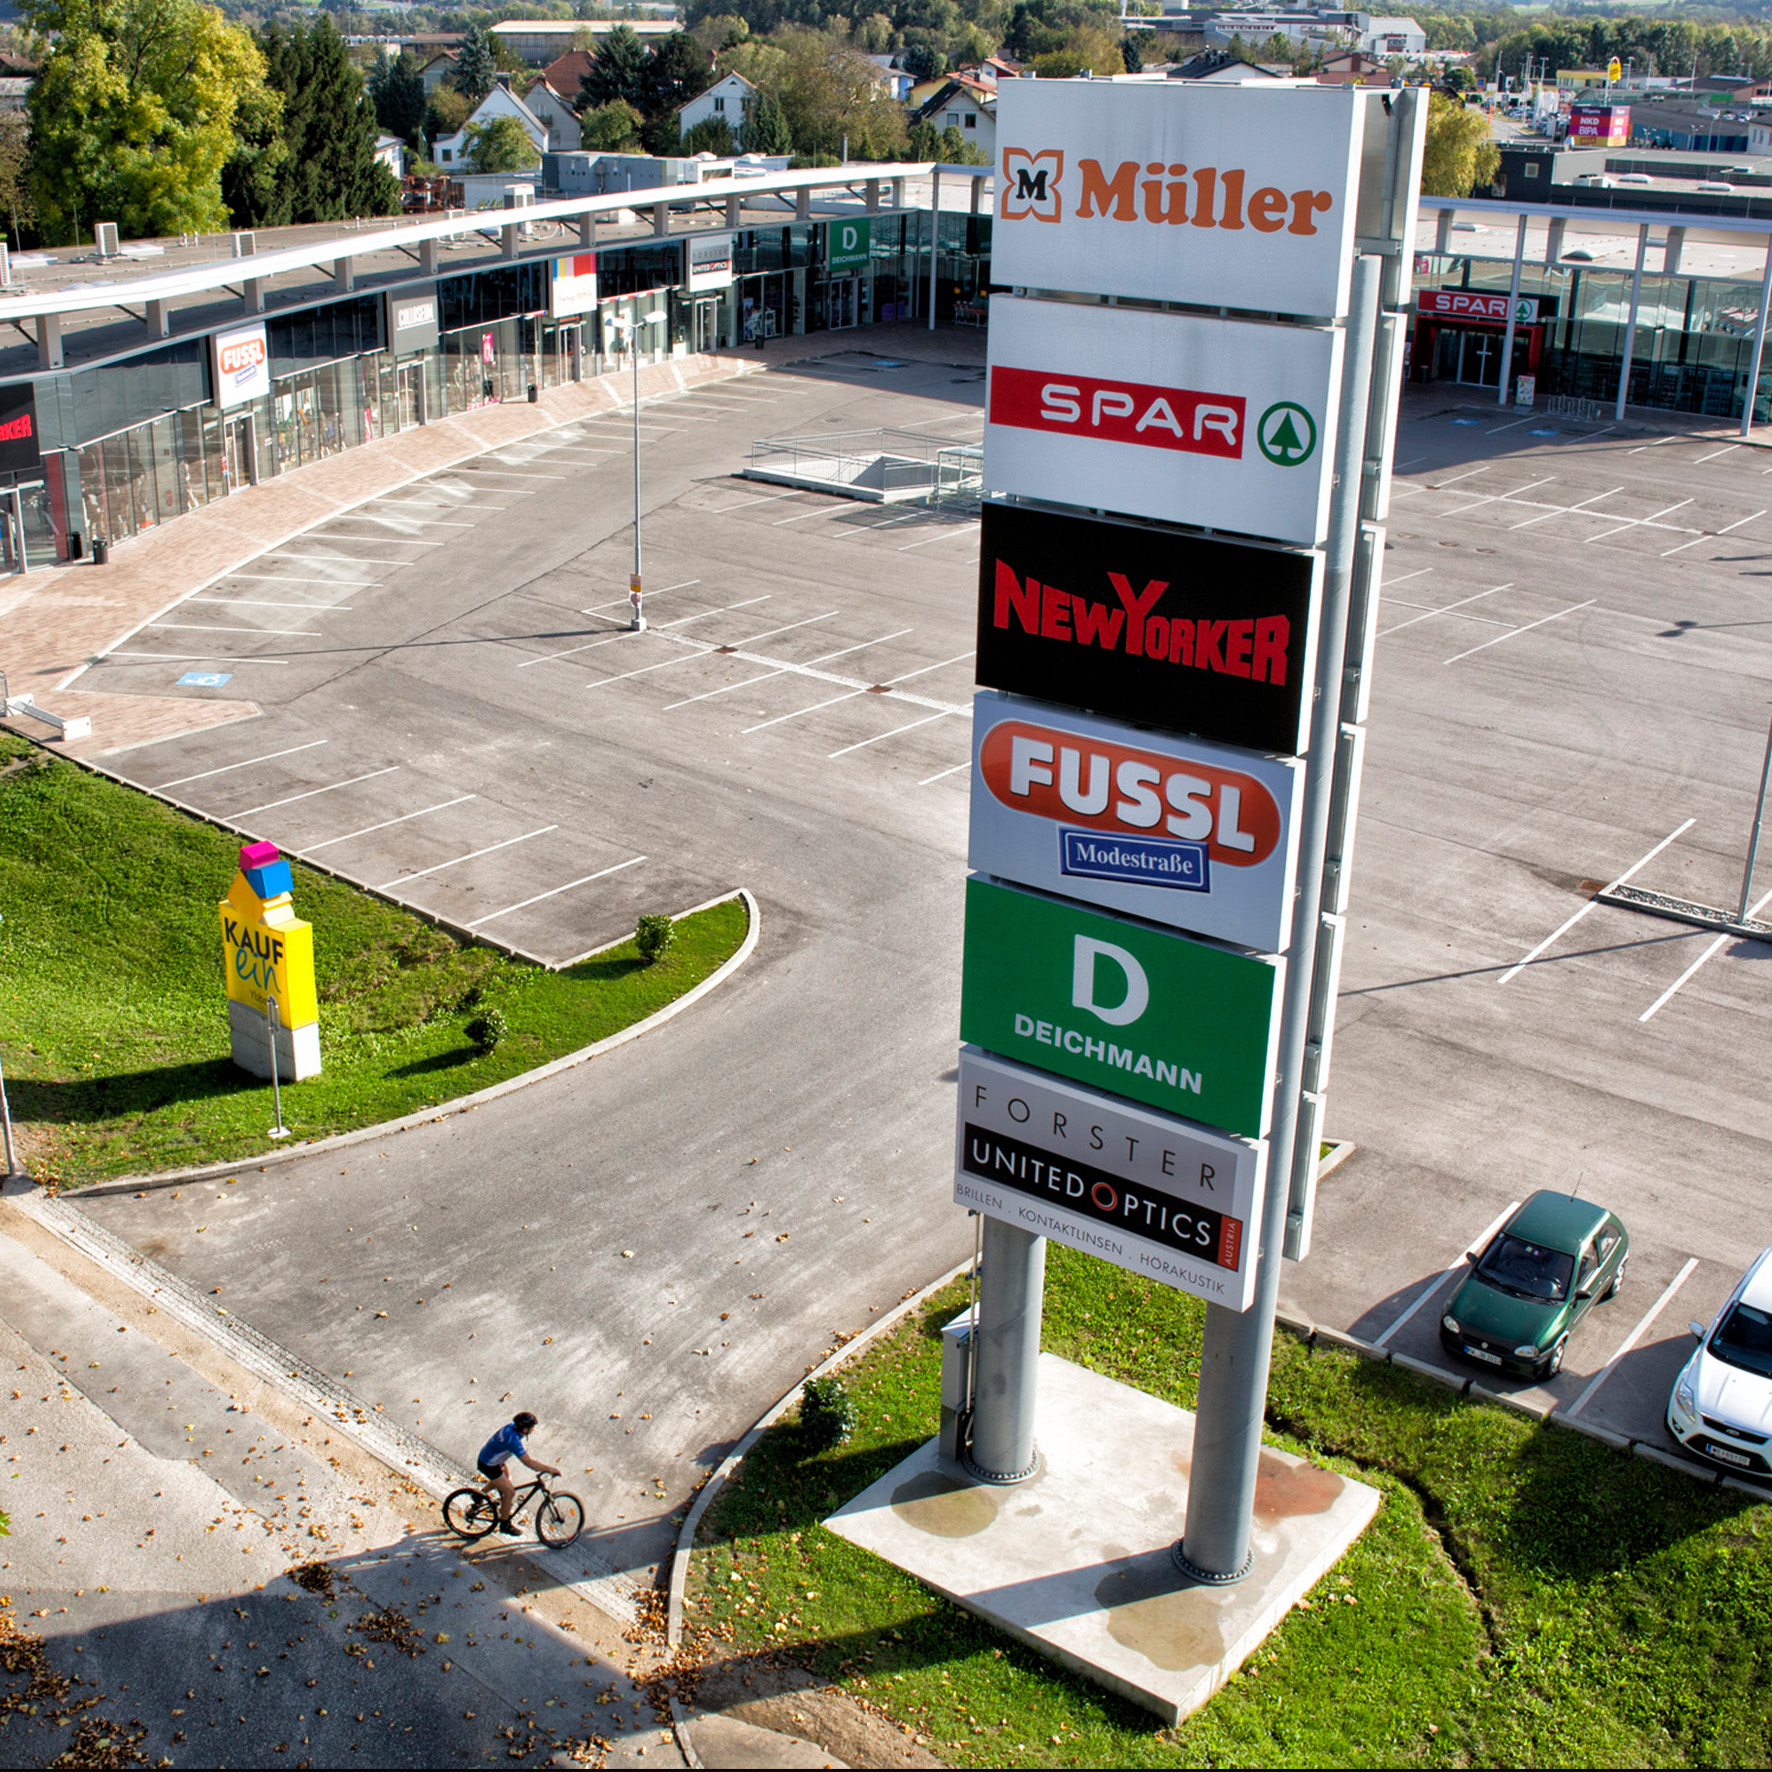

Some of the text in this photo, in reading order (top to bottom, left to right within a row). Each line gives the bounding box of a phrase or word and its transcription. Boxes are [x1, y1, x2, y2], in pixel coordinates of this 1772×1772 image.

[1578, 126, 1598, 136] BIPA
[1016, 170, 1048, 201] M
[1075, 159, 1332, 235] Müller
[842, 226, 857, 250] D
[1435, 294, 1505, 316] SPAR
[223, 341, 264, 370] FUSSL
[1040, 383, 1238, 446] SPAR
[1010, 735, 1255, 853] FUSSL
[1076, 842, 1193, 874] Modestraße
[224, 916, 283, 965] KAUF
[236, 948, 282, 993] ein
[1072, 933, 1150, 1026] D
[1014, 1013, 1203, 1095] DEICHMANN
[975, 1084, 1216, 1192] FORSTER
[956, 1183, 1225, 1295] BRILLEN KONTAKTLINSEN HÖRAKUSTIK
[1224, 1222, 1236, 1266] AUSTRIA
